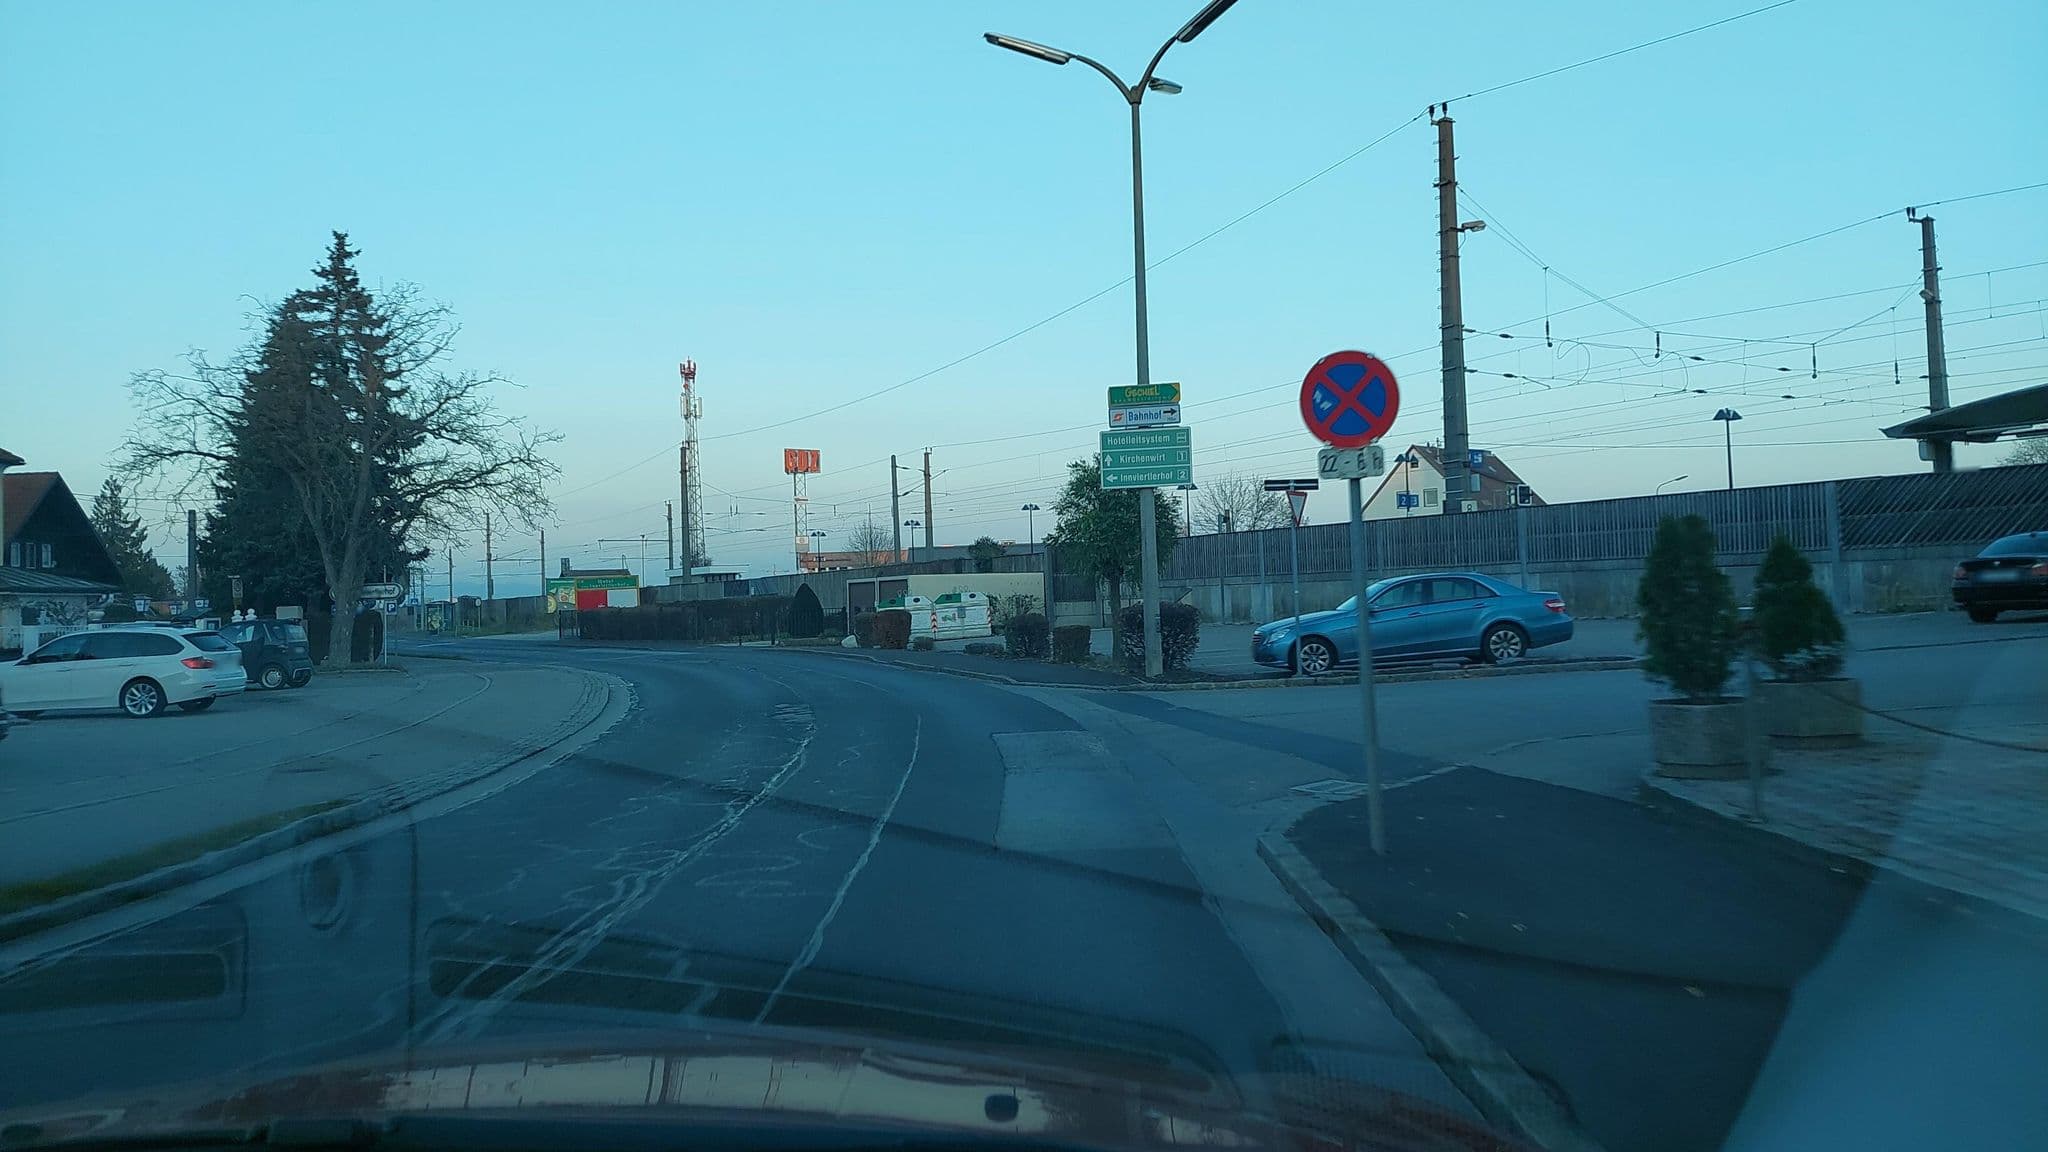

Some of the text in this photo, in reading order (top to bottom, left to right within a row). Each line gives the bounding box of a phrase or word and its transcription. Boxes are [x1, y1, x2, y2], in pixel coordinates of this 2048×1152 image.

[1128, 409, 1162, 422] Bahnhof
[1107, 434, 1170, 446] Hotelleitsystem
[1119, 453, 1166, 464] Kirchenwirt
[1321, 454, 1338, 473] 22
[1120, 471, 1173, 483] Innviertlerhof
[1401, 496, 1406, 506] 2
[388, 603, 395, 612] P
